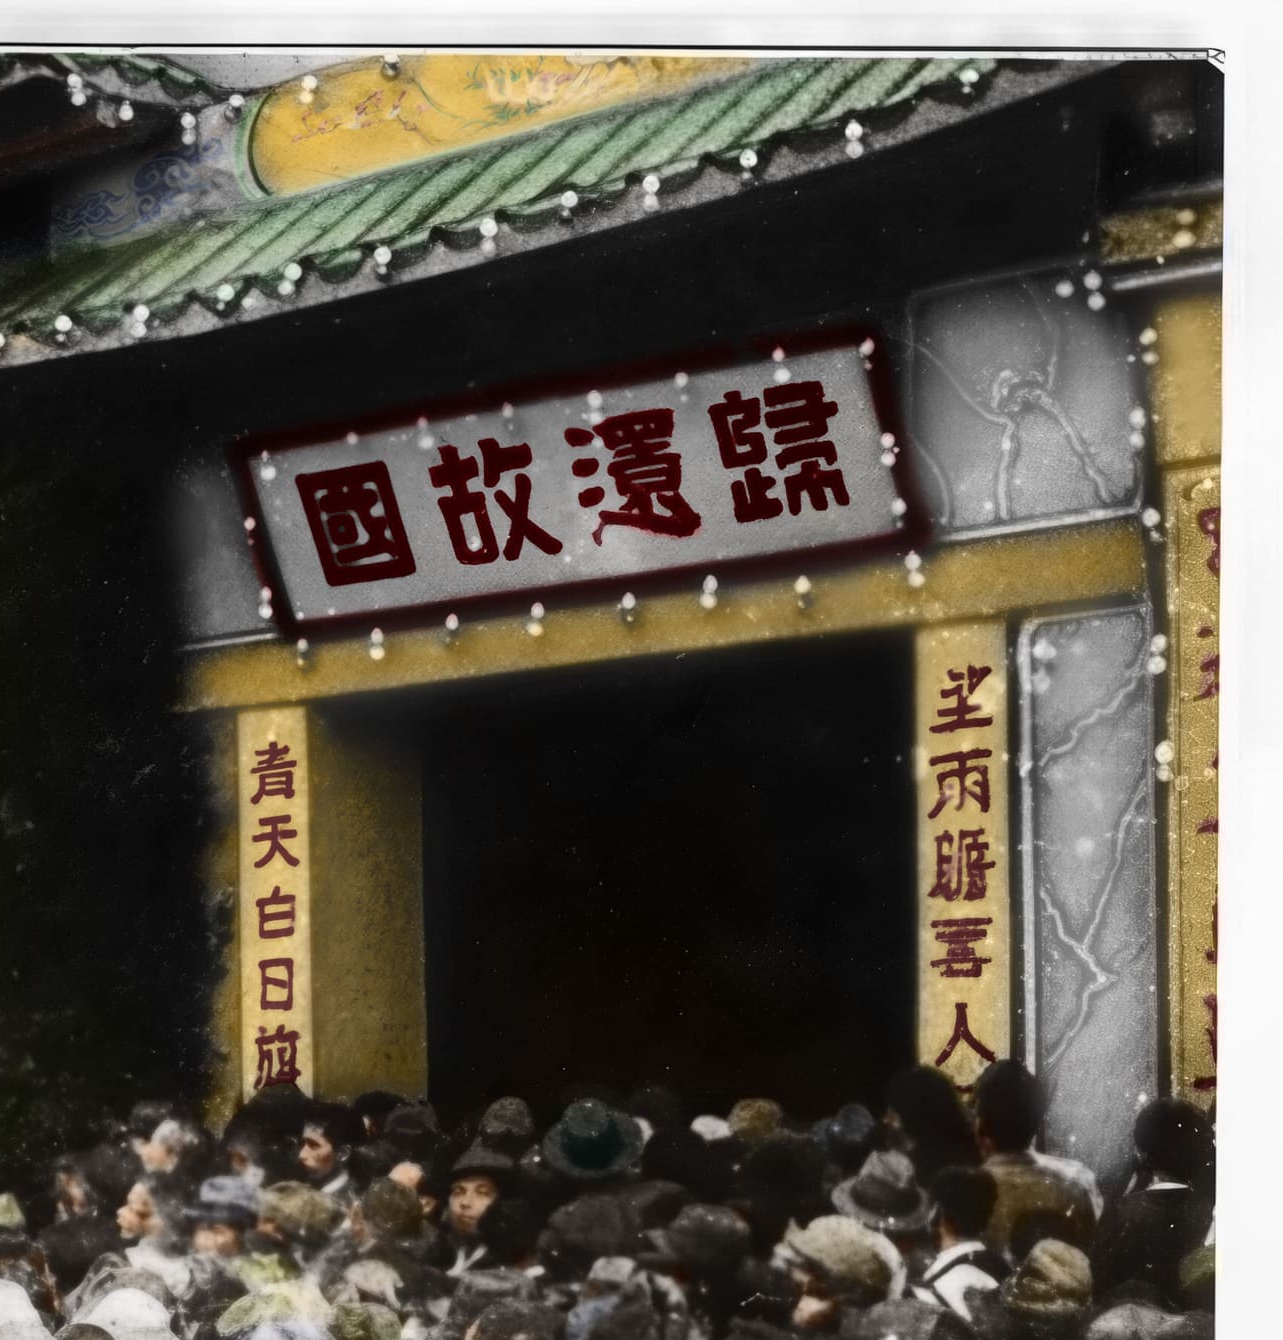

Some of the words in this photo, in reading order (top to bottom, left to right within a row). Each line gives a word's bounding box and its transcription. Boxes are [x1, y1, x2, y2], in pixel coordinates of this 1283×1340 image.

[293, 380, 850, 587] 歸還故國
[250, 741, 300, 1090] 青天白日旗
